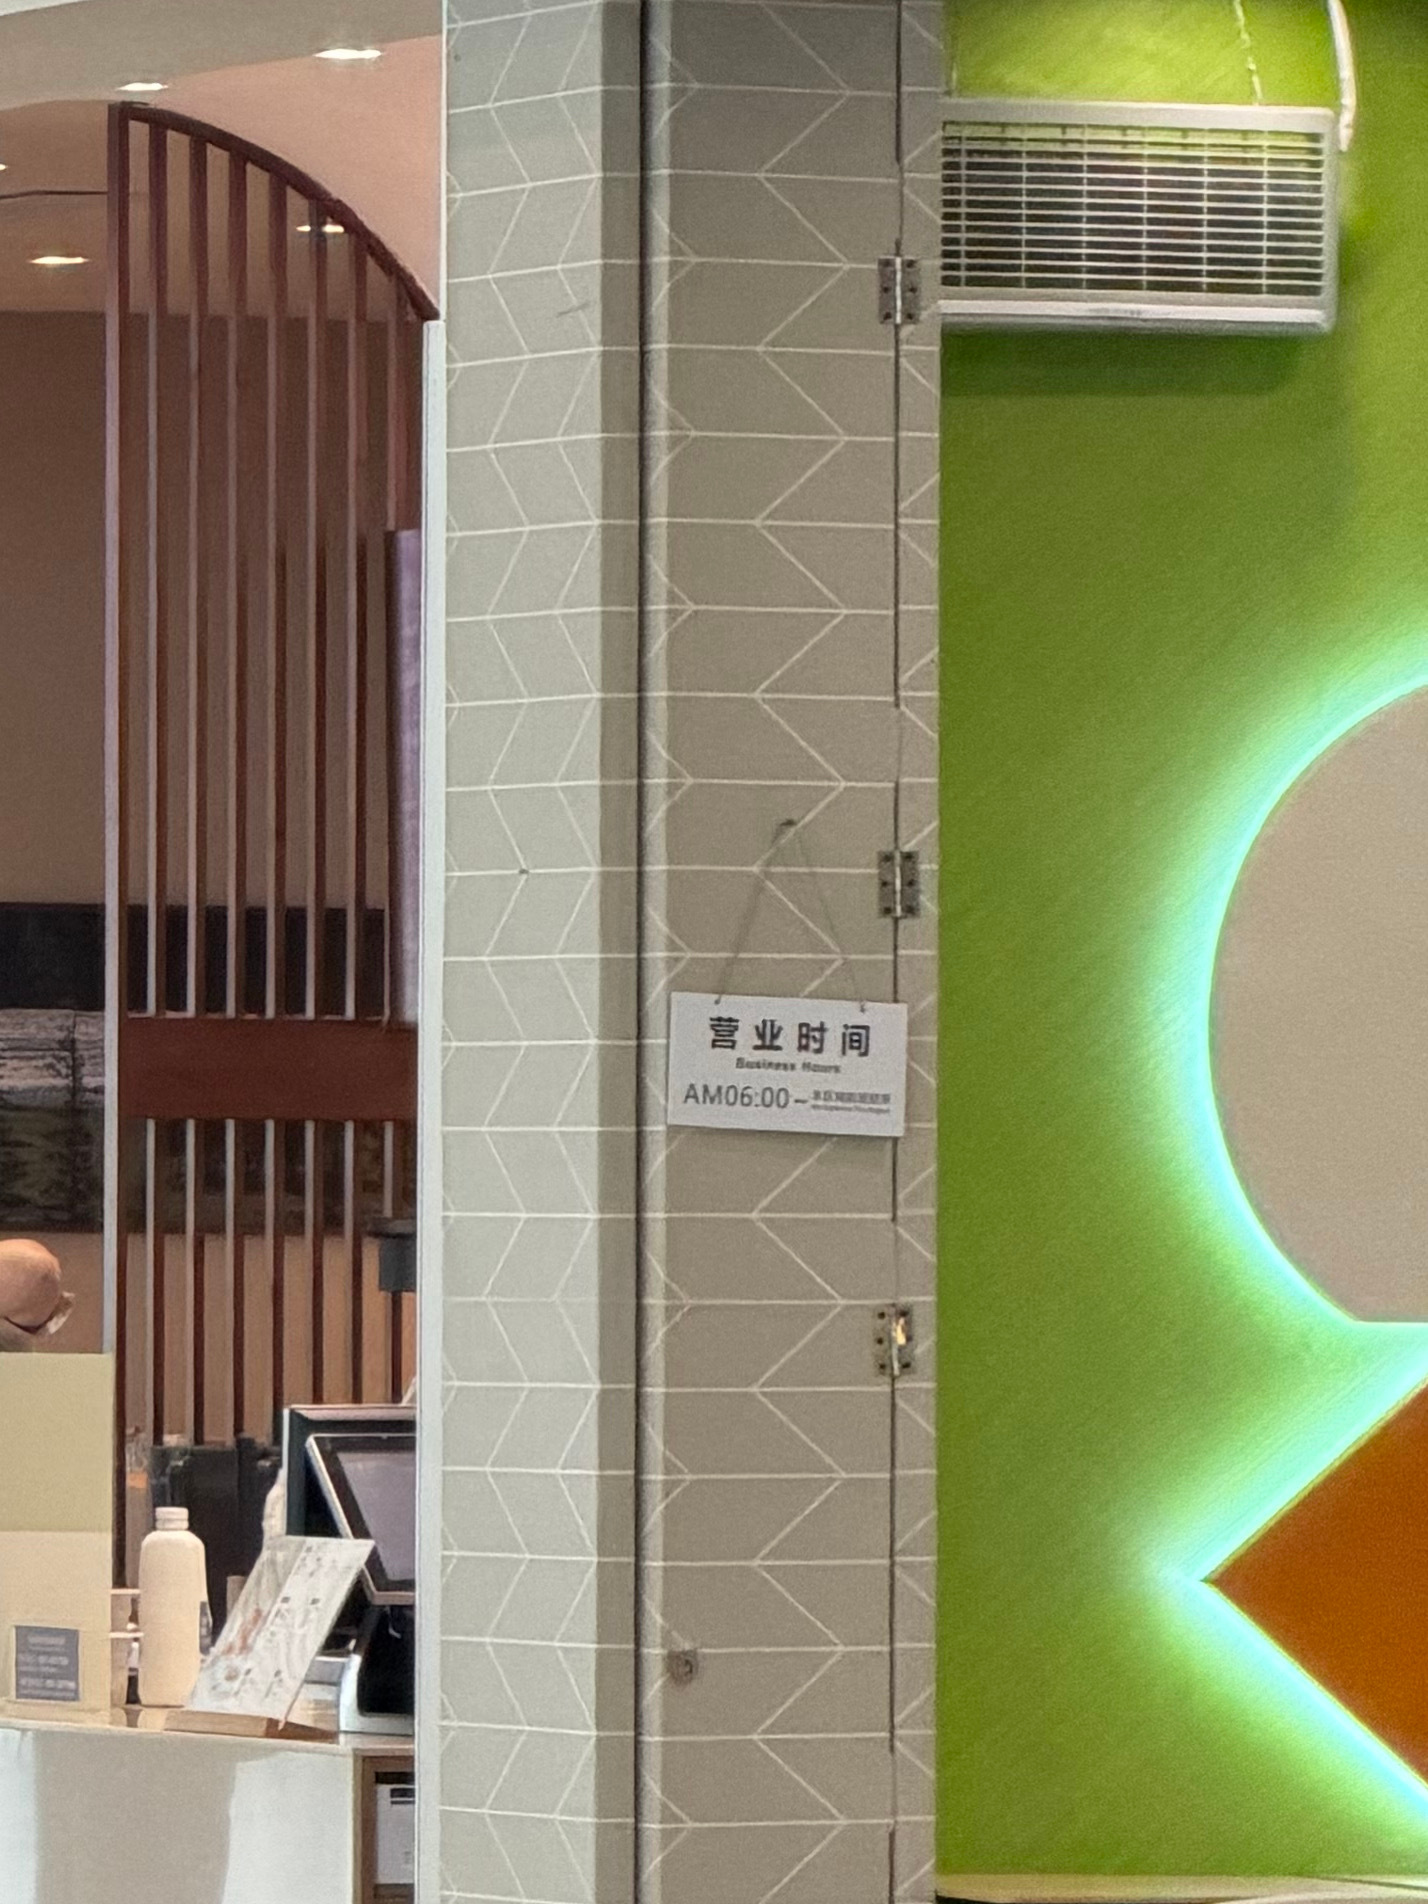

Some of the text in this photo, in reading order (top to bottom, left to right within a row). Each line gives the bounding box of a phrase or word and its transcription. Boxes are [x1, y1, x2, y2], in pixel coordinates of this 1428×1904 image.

[709, 1016, 871, 1057] 营业时间
[735, 1057, 796, 1072] Business
